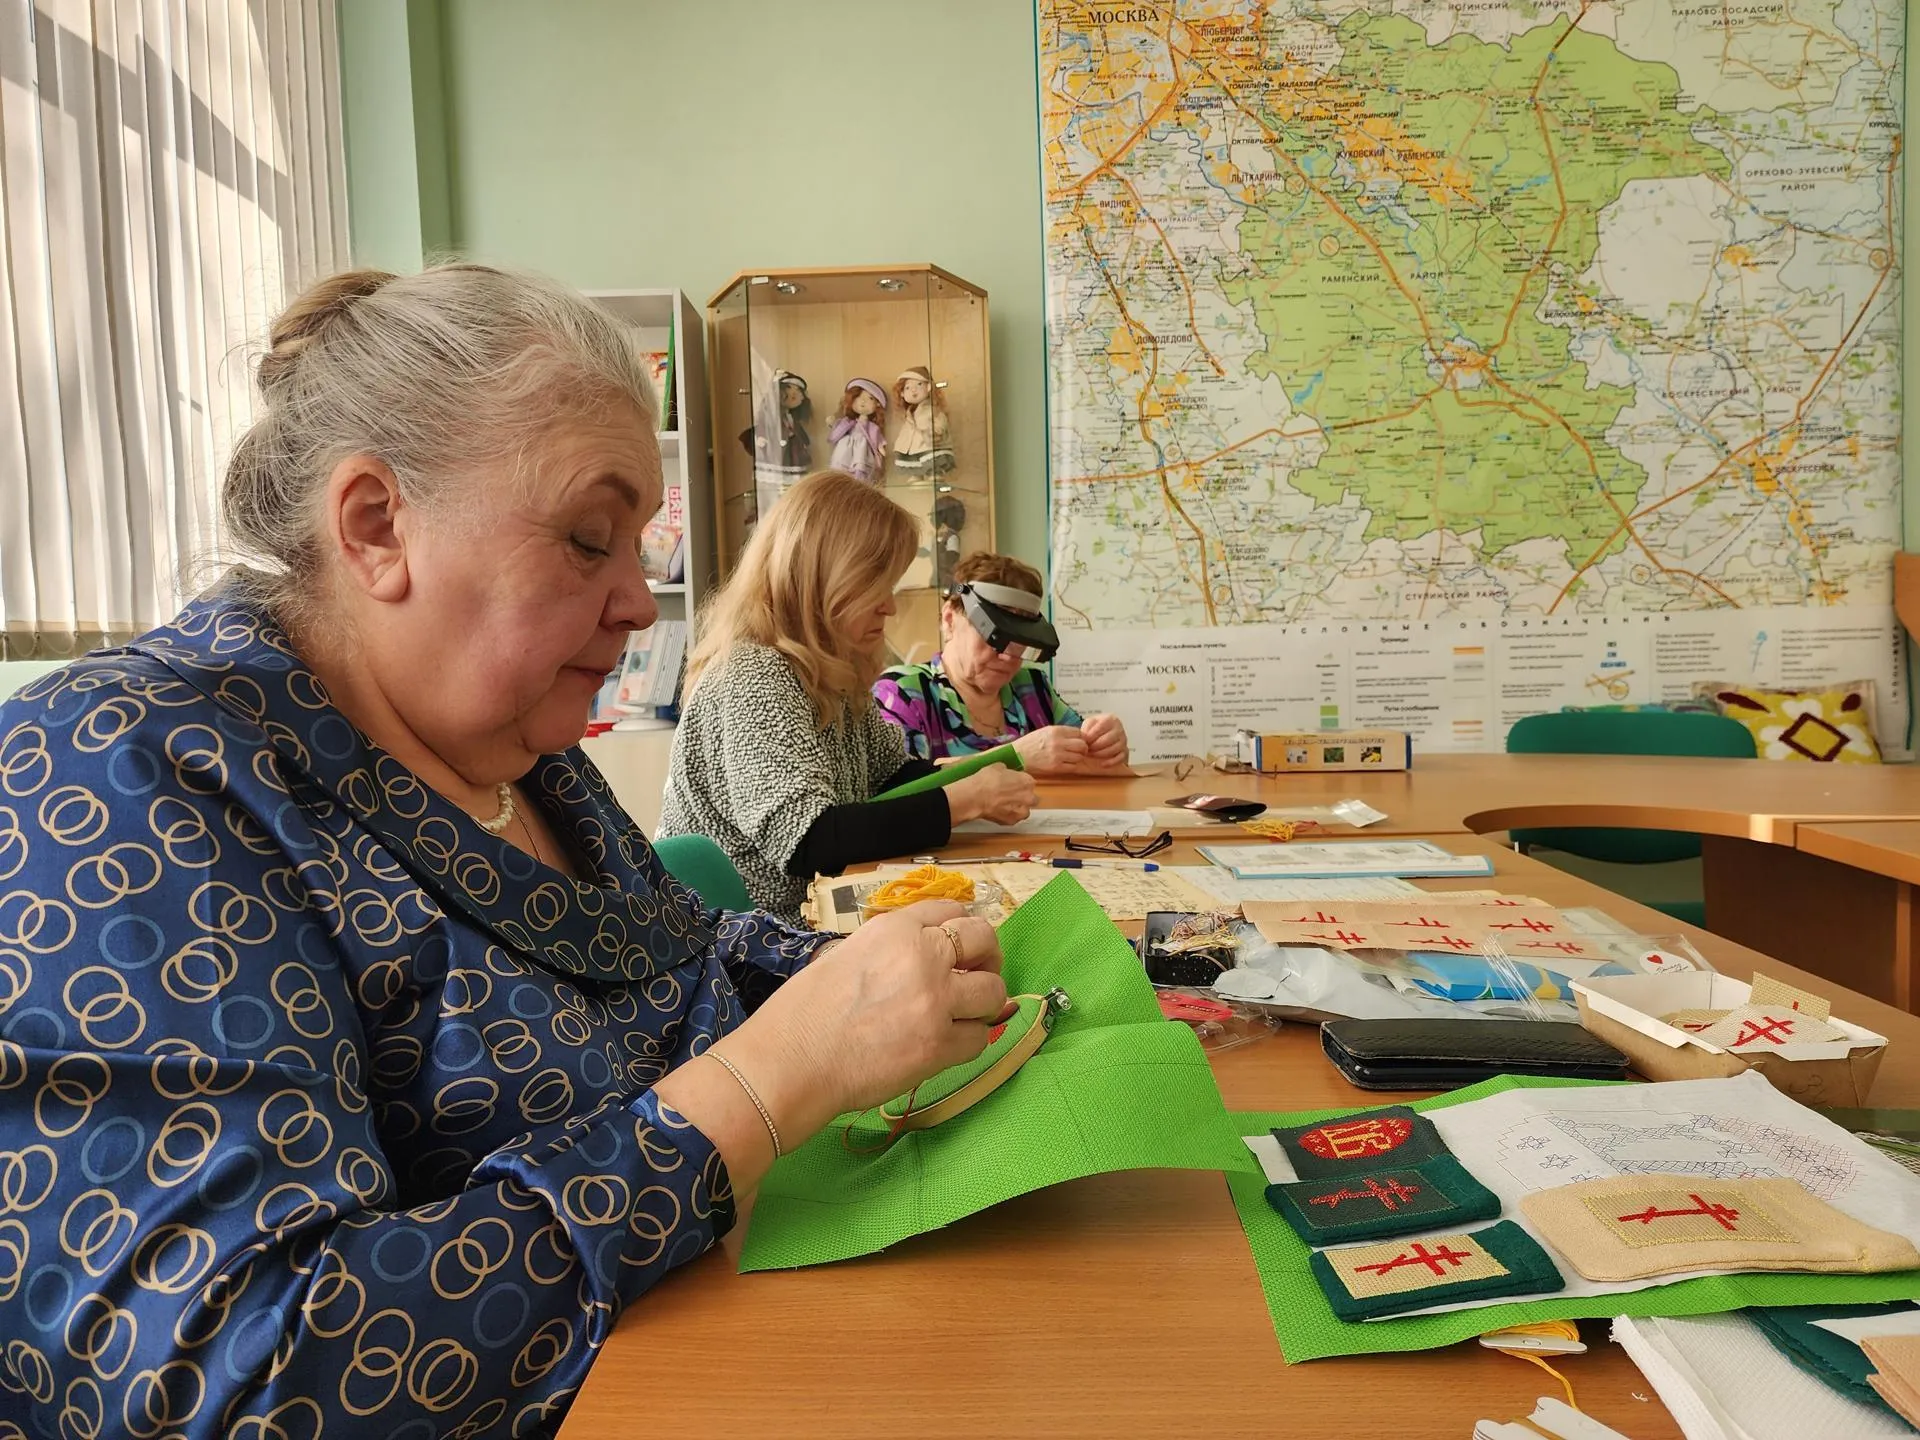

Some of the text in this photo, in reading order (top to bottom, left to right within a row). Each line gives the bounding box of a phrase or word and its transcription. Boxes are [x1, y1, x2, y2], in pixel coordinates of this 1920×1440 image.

[1088, 9, 1160, 24] МОСКВА
[1781, 184, 1816, 192] РАЙОН
[1099, 200, 1132, 208] ВИДНОЕ
[1321, 275, 1380, 283] РАМЕНСКИЙ
[1146, 665, 1196, 675] МОСКВА
[1149, 705, 1194, 714] БАЛАШИХА
